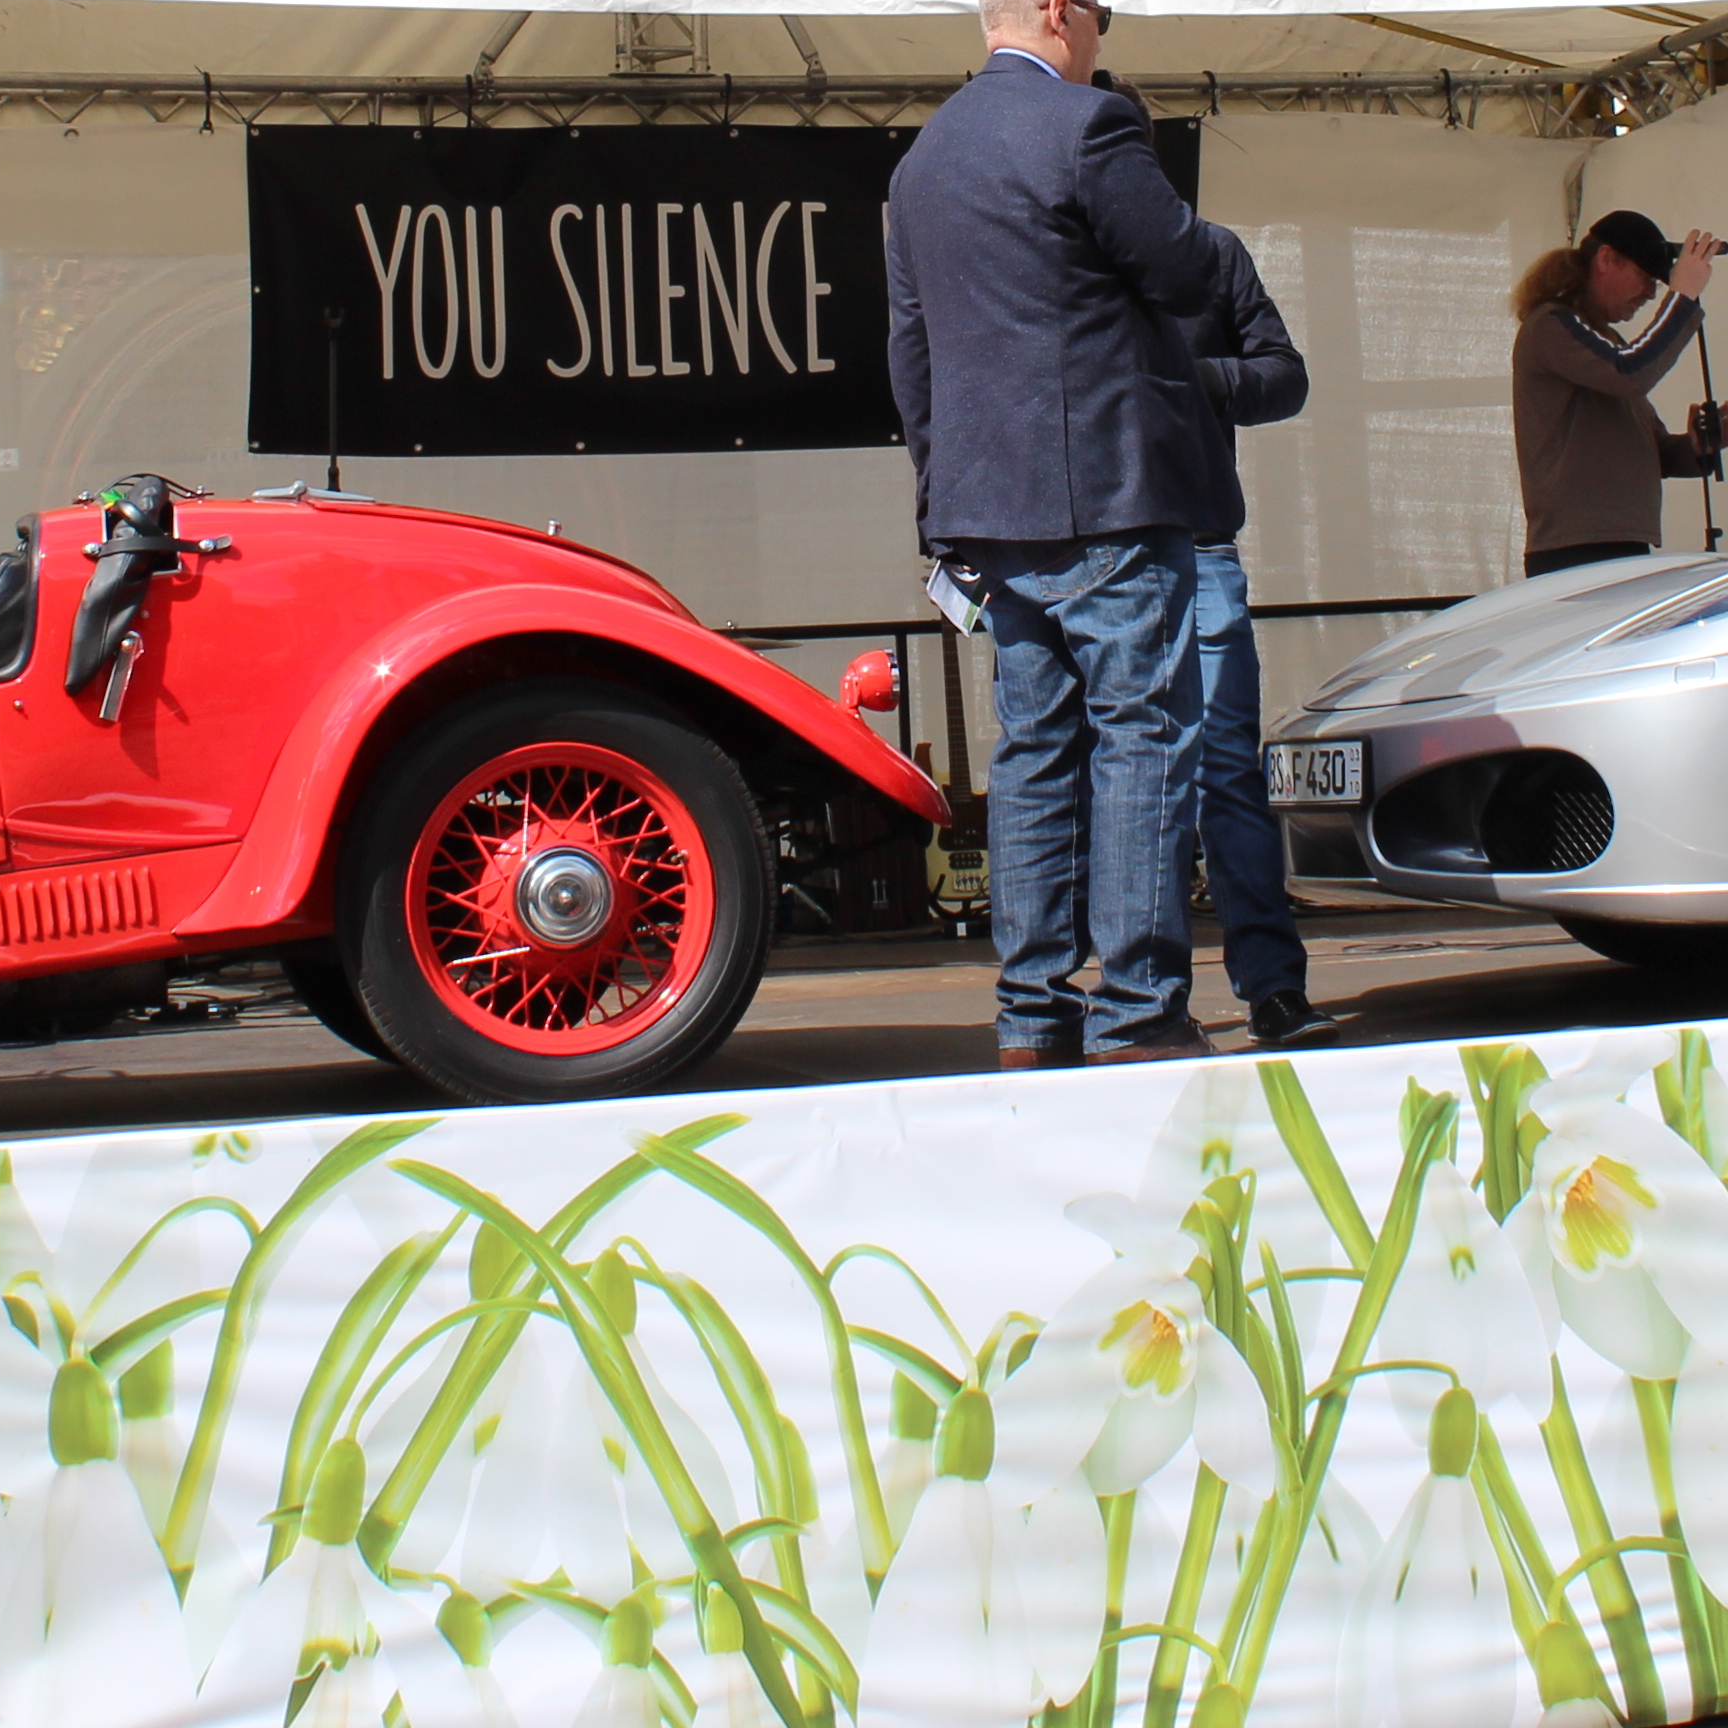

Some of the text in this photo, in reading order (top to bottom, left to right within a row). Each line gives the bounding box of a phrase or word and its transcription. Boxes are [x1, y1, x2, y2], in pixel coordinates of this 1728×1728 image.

[356, 203, 506, 380] YOU
[547, 200, 836, 379] SILENCE
[1293, 751, 1302, 794] F
[1306, 749, 1346, 797] 430
